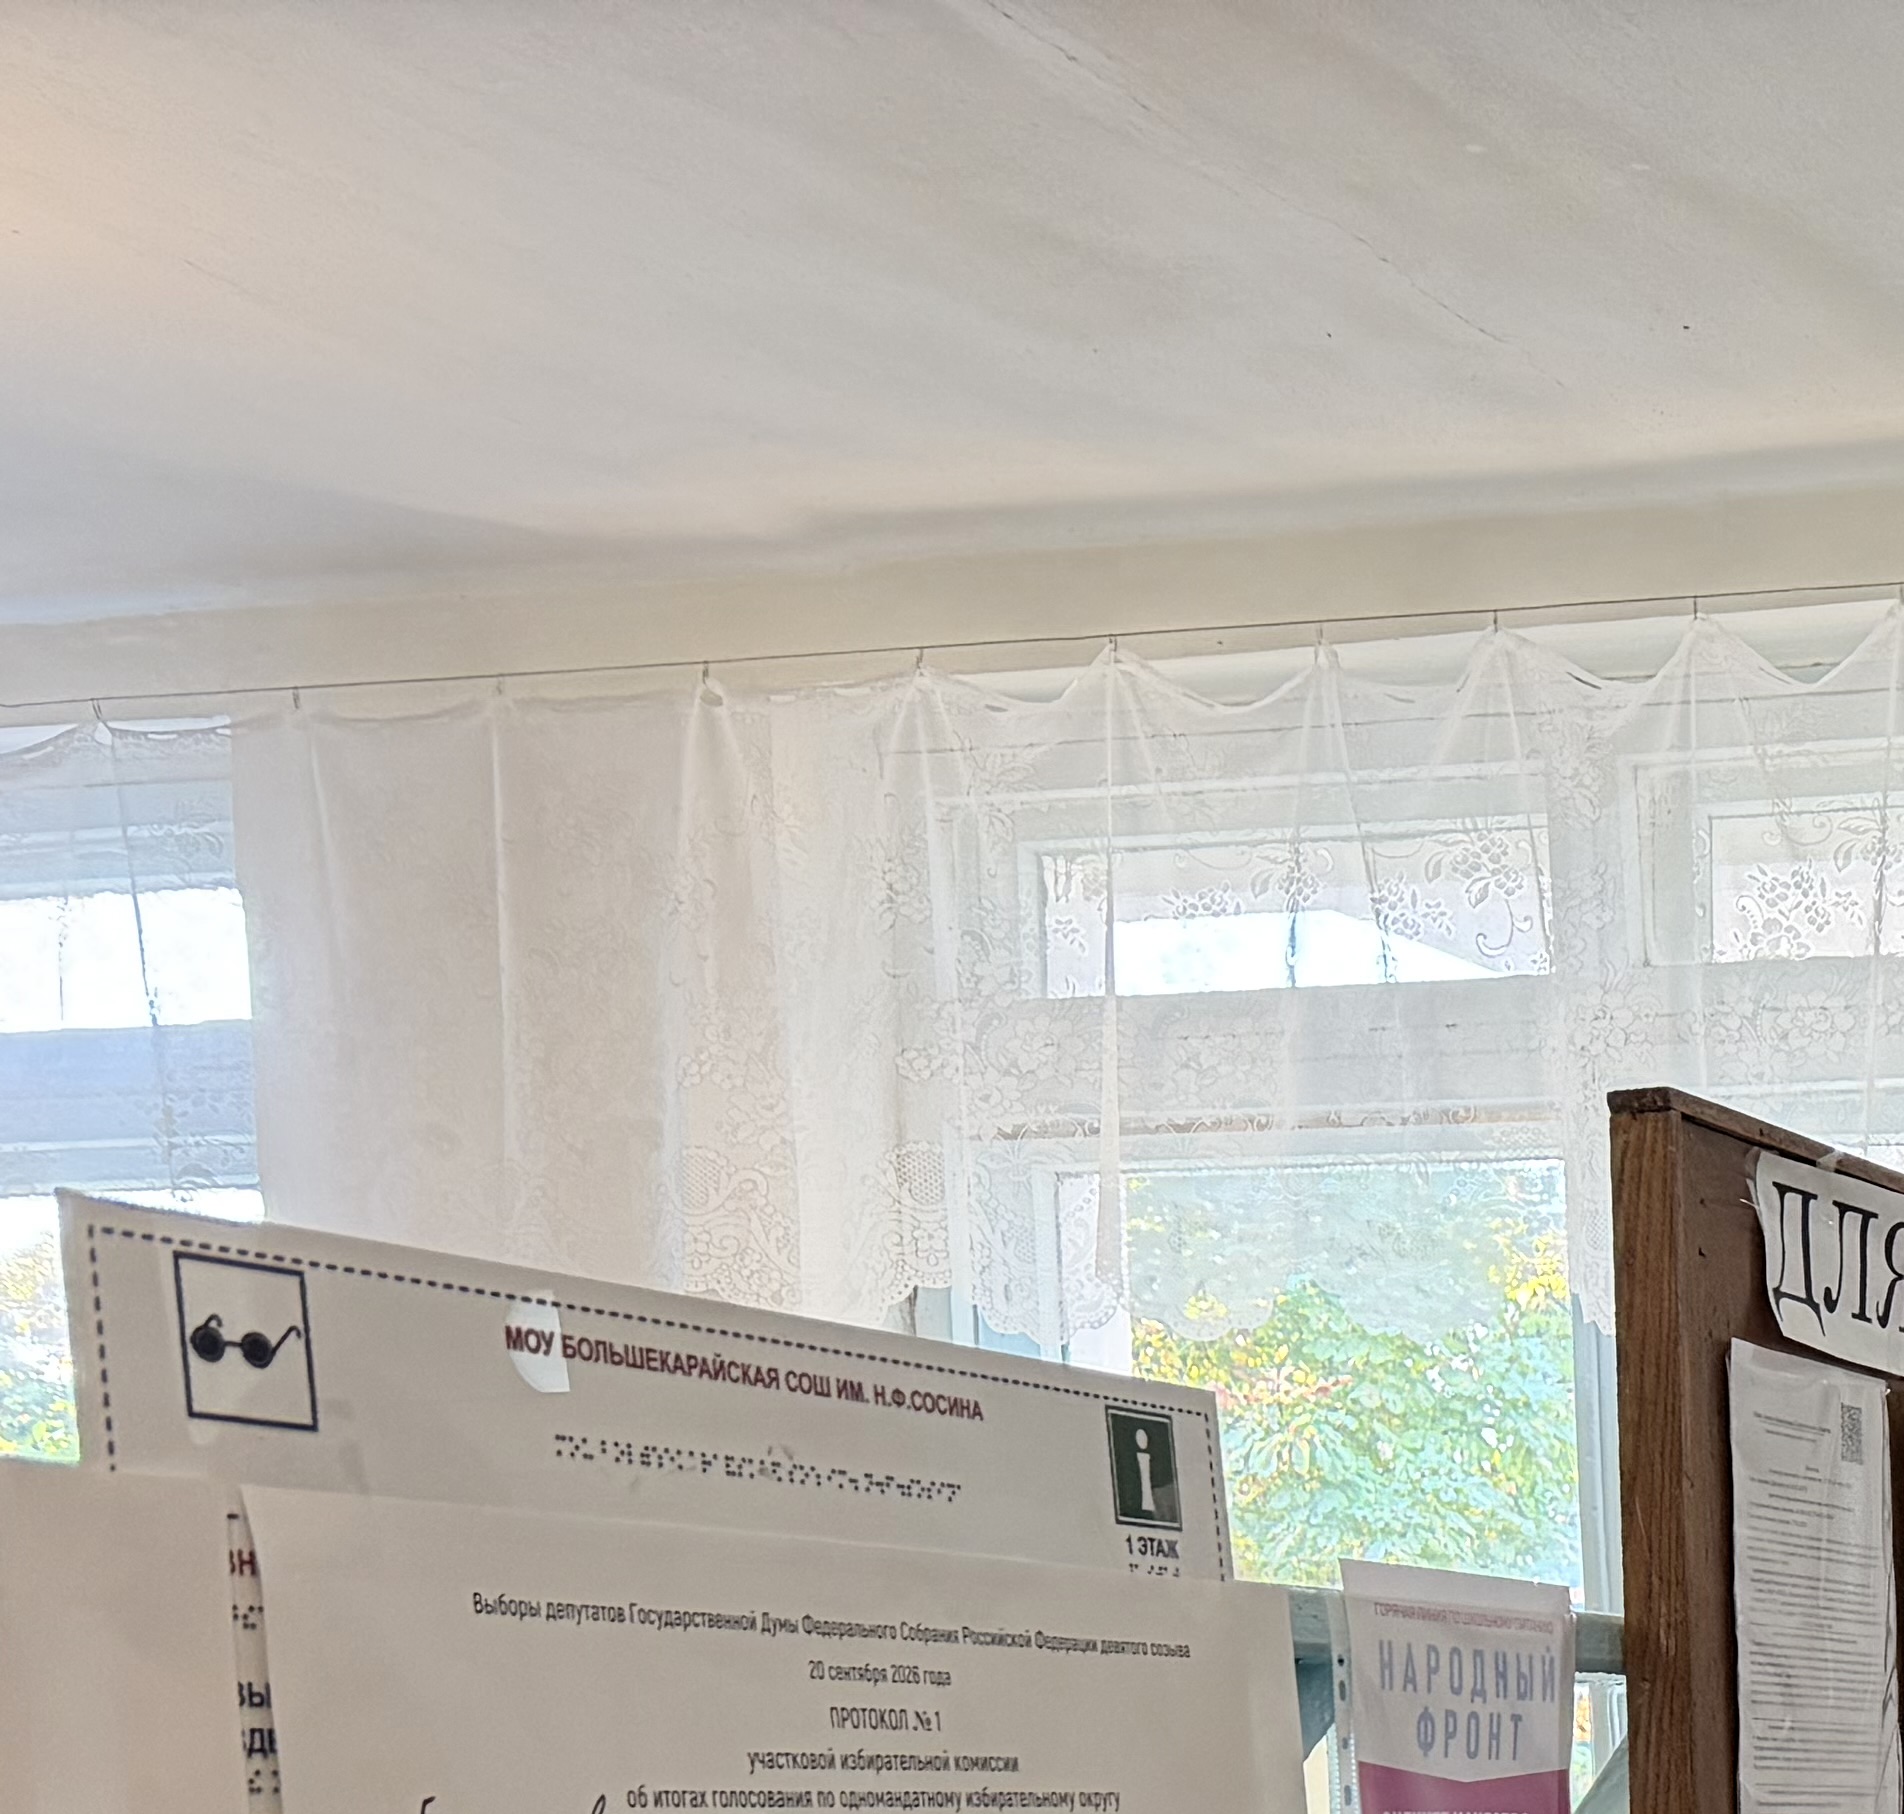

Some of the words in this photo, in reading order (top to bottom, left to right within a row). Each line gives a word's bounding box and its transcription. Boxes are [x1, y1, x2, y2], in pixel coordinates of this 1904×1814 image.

[505, 1325, 554, 1355] МОУ
[562, 1334, 780, 1389] БОЛЬШЕКАРАЙСКАЯ
[785, 1369, 830, 1397] СОШ
[836, 1377, 868, 1402] ИМ.
[874, 1384, 982, 1420] Н.Ф.СОСИНА
[1125, 1534, 1134, 1554] 1
[1137, 1535, 1180, 1559] ЭТАЖ
[473, 1591, 540, 1620] Выборы
[545, 1601, 625, 1625] депутатов
[629, 1602, 757, 1631] Государственной
[761, 1611, 798, 1637] Думы
[802, 1613, 896, 1640] Федерального
[901, 1621, 958, 1644] Собрания
[963, 1626, 1032, 1648] Российской
[1035, 1630, 1097, 1653] Федерации
[1100, 1639, 1147, 1655] девятого
[1151, 1643, 1189, 1658] созыва
[809, 1660, 823, 1679] 20
[828, 1663, 887, 1685] сентября
[891, 1664, 919, 1684] 2026
[923, 1670, 950, 1686] года
[1378, 1637, 1556, 1704] НАРОДНЫЙ
[830, 1706, 907, 1730] ПРОТОКОЛ
[934, 1710, 941, 1730] 1
[1416, 1705, 1524, 1762] ФРОНТ
[748, 1747, 835, 1775] участковой
[840, 1748, 949, 1774] избирательной
[954, 1755, 1018, 1771] комиссии
[628, 1785, 647, 1808] об
[653, 1790, 707, 1808] итогах
[712, 1790, 812, 1808] голосования
[817, 1790, 834, 1808] по
[839, 1790, 961, 1812] одномандатному
[966, 1786, 1074, 1811] избирательному
[1079, 1791, 1120, 1811] округу
